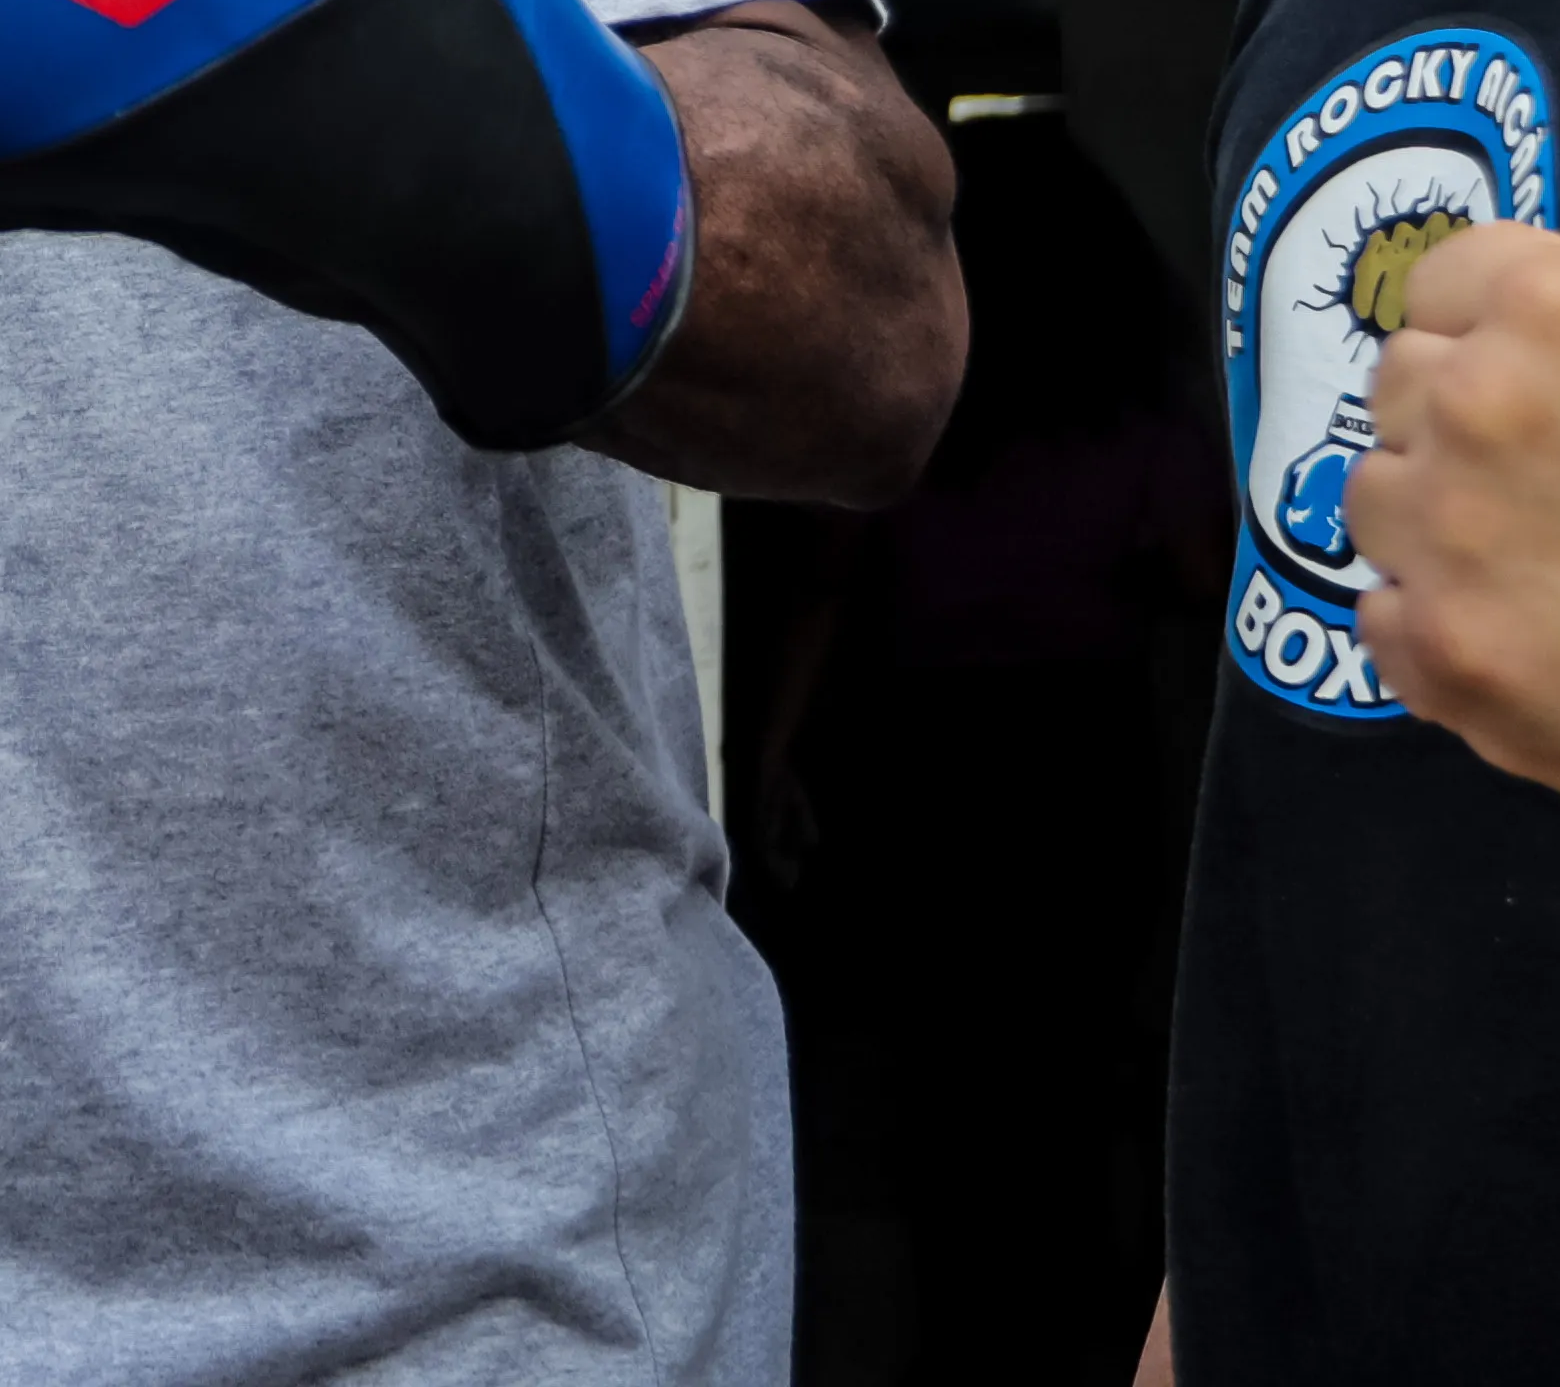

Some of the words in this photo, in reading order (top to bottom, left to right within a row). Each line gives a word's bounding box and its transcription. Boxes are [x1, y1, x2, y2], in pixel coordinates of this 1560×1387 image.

[1226, 169, 1280, 358] TEAM
[1285, 48, 1479, 168] ROCKY
[1235, 569, 1398, 703] BOX
